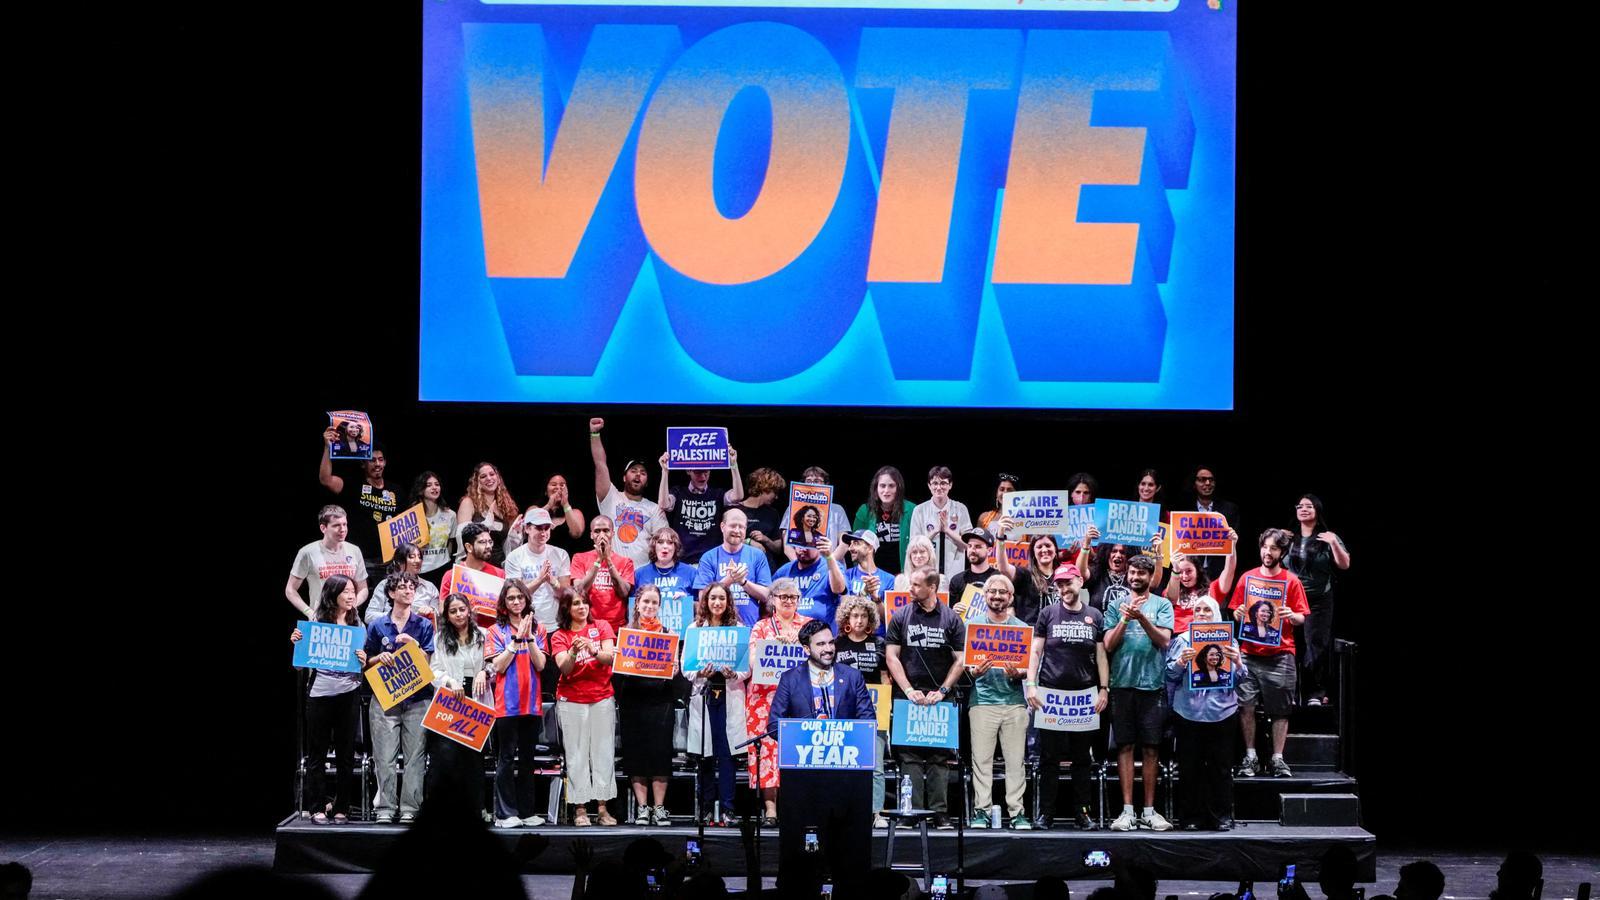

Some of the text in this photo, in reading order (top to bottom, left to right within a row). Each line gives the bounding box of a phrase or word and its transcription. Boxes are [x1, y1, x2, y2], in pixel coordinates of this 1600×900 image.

[462, 21, 1170, 285] VOTE
[680, 432, 718, 448] FREE
[670, 448, 726, 461] PALESTINE
[360, 500, 396, 512] MOVEMENT
[681, 504, 716, 518] NIOU
[1108, 502, 1148, 522] BRAD
[390, 511, 418, 538] BRAD
[1025, 520, 1064, 528] CONGRESS
[1106, 519, 1148, 536] LANDER
[1180, 517, 1224, 528] CLAIRE
[1176, 530, 1230, 540] VALDEZ
[654, 577, 678, 587] UAW
[794, 576, 812, 588] AW
[310, 626, 352, 646] BRAD
[698, 630, 738, 647] BRAD
[976, 628, 1023, 642] CLAIRE
[1052, 630, 1093, 639] SOCIALISTS
[627, 634, 671, 650] CLAIRE
[971, 641, 1028, 654] VALDEZ
[308, 642, 350, 660] LANDER
[622, 647, 672, 662] VALDEZ
[697, 646, 737, 661] LANDER
[987, 654, 1023, 662] CONGRESS
[320, 659, 348, 667] Congress
[377, 650, 413, 682] BRAD
[635, 661, 667, 670] CONGRESS
[385, 664, 421, 695] LANDER
[402, 678, 423, 695] Congress
[1046, 693, 1092, 706] CLAIRE
[435, 692, 494, 727] MEDICARE
[908, 703, 950, 722] BRAD
[1042, 706, 1096, 717] VALDEZ
[435, 712, 453, 723] FOR
[1058, 716, 1093, 726] CONGRESS
[449, 718, 476, 738] ALL
[801, 721, 854, 731] OUR TEAM
[906, 721, 948, 736] LANDER
[811, 731, 845, 746] OUR
[919, 736, 947, 744] Congress
[795, 745, 859, 766] YEAR
